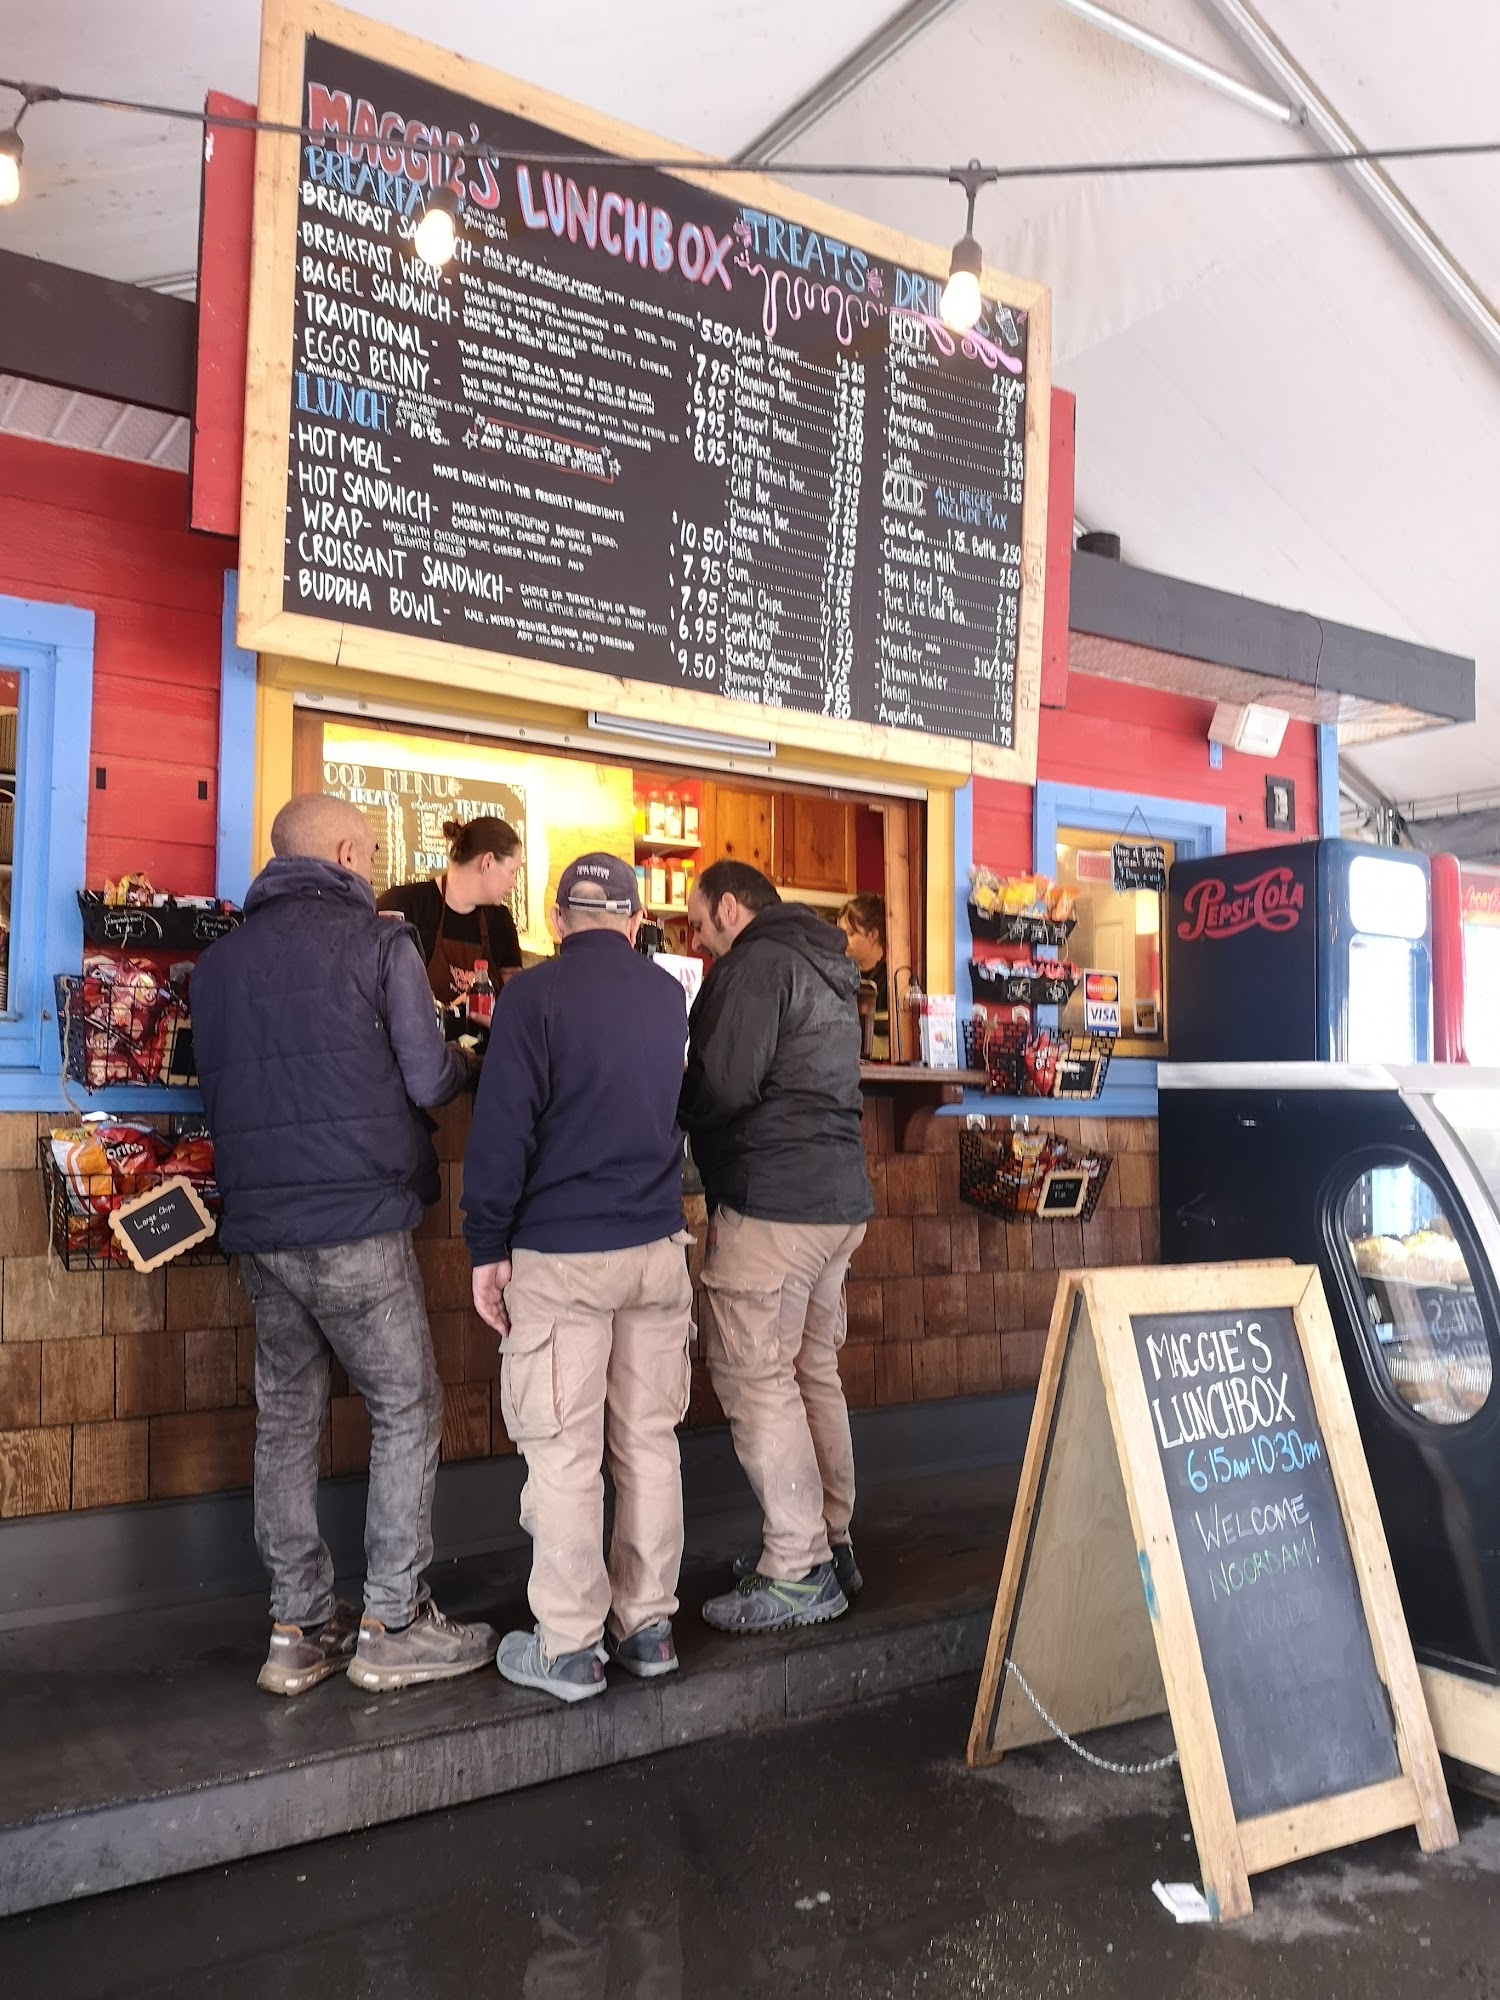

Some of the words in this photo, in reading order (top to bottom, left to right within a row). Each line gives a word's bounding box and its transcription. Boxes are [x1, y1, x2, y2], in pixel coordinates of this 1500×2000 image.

[308, 81, 500, 210] MAGGIE'S
[516, 164, 733, 292] LUNCHBOX
[302, 181, 392, 238] BREAKFAST
[302, 221, 393, 275] BREAKFAST
[741, 207, 868, 294] TREATS
[302, 256, 364, 297] BAGEL
[304, 326, 361, 373] EGGS
[735, 327, 762, 352] Apple
[765, 334, 800, 365] Turnover
[890, 312, 926, 350] HOT
[735, 345, 765, 374] Carrot
[768, 357, 792, 383] Cake
[888, 343, 918, 369] Coffee
[889, 360, 908, 387] Tea
[296, 371, 390, 434] LUNCH
[306, 361, 353, 384] AVAILABLE
[356, 374, 397, 397] TUESDAYS
[454, 402, 474, 418] ONLY
[734, 386, 771, 415] Cookies
[735, 366, 775, 399] Nanaimo
[778, 380, 798, 405] Bars
[890, 382, 927, 412] Espresso
[395, 419, 407, 430] AT
[734, 406, 768, 437] Dessert
[772, 419, 798, 447] Bread
[889, 405, 934, 437] Americano
[298, 421, 337, 460] HOT
[480, 433, 502, 450] AND
[570, 457, 605, 476] OPTIONS
[507, 427, 519, 442] US
[523, 433, 551, 451] ABOUT
[554, 441, 572, 458] OUR
[574, 446, 603, 464] VEGGIE
[732, 429, 771, 460] Muffins
[888, 426, 920, 454] Mocha
[298, 460, 338, 499] HOT
[757, 460, 787, 488] Protein
[789, 470, 806, 494] Bar
[887, 450, 913, 475] Latte
[433, 463, 460, 482] MADE
[462, 469, 486, 488] DAILY
[487, 476, 512, 495] WITH
[513, 483, 531, 499] THE
[535, 488, 573, 510] FRESHEST
[574, 498, 625, 524] INGREDIENTS
[755, 482, 771, 505] Bar
[882, 475, 927, 512] COLD
[935, 484, 957, 505] ALL
[959, 489, 993, 514] PRICES
[729, 498, 772, 527] Chocolate
[774, 510, 790, 533] Bar
[730, 517, 760, 543] Reese
[763, 526, 781, 549] Mix
[937, 501, 981, 527] INCLUDE
[985, 511, 1008, 533] TAX
[298, 531, 408, 580] CROISSANT
[729, 536, 753, 563] Halls
[883, 515, 907, 538] Coke
[908, 520, 926, 542] Can
[971, 535, 997, 561] Bottle
[883, 538, 931, 568] Chocolate
[934, 549, 957, 575] Milk
[299, 568, 372, 612] BUDDHA
[727, 559, 750, 584] Gum
[884, 563, 910, 591] Brisk
[913, 570, 933, 596] Iced
[937, 576, 954, 606] Tea
[727, 582, 754, 608] Small
[757, 588, 783, 620] Chips
[884, 588, 904, 612] Pure
[905, 594, 926, 617] Life
[928, 595, 946, 620] Iced
[948, 602, 966, 626] Tea
[724, 624, 748, 647] Corn
[750, 629, 772, 652] Nuts
[725, 602, 752, 633] Large
[754, 610, 780, 640] Chips
[882, 609, 912, 637] Juice
[725, 643, 765, 671] Roasted
[767, 653, 802, 677] Almonds
[880, 635, 923, 665] Monster
[724, 663, 761, 688] Pepperoni
[762, 671, 791, 694] Sticks
[880, 657, 918, 686] Vitamin
[919, 668, 949, 692] Water
[881, 678, 912, 704] Dasani
[878, 702, 924, 730] Aquafina
[322, 761, 367, 788] OOD
[383, 768, 449, 798] MENU
[350, 786, 400, 806] TREATS
[1090, 1007, 1117, 1021] VISA
[133, 1212, 158, 1231] Large
[158, 1202, 176, 1216] Chips
[1146, 1320, 1272, 1381] MAGGIE'S
[1152, 1372, 1296, 1449] LUNCHBOX
[1194, 1493, 1310, 1553] WELCOME
